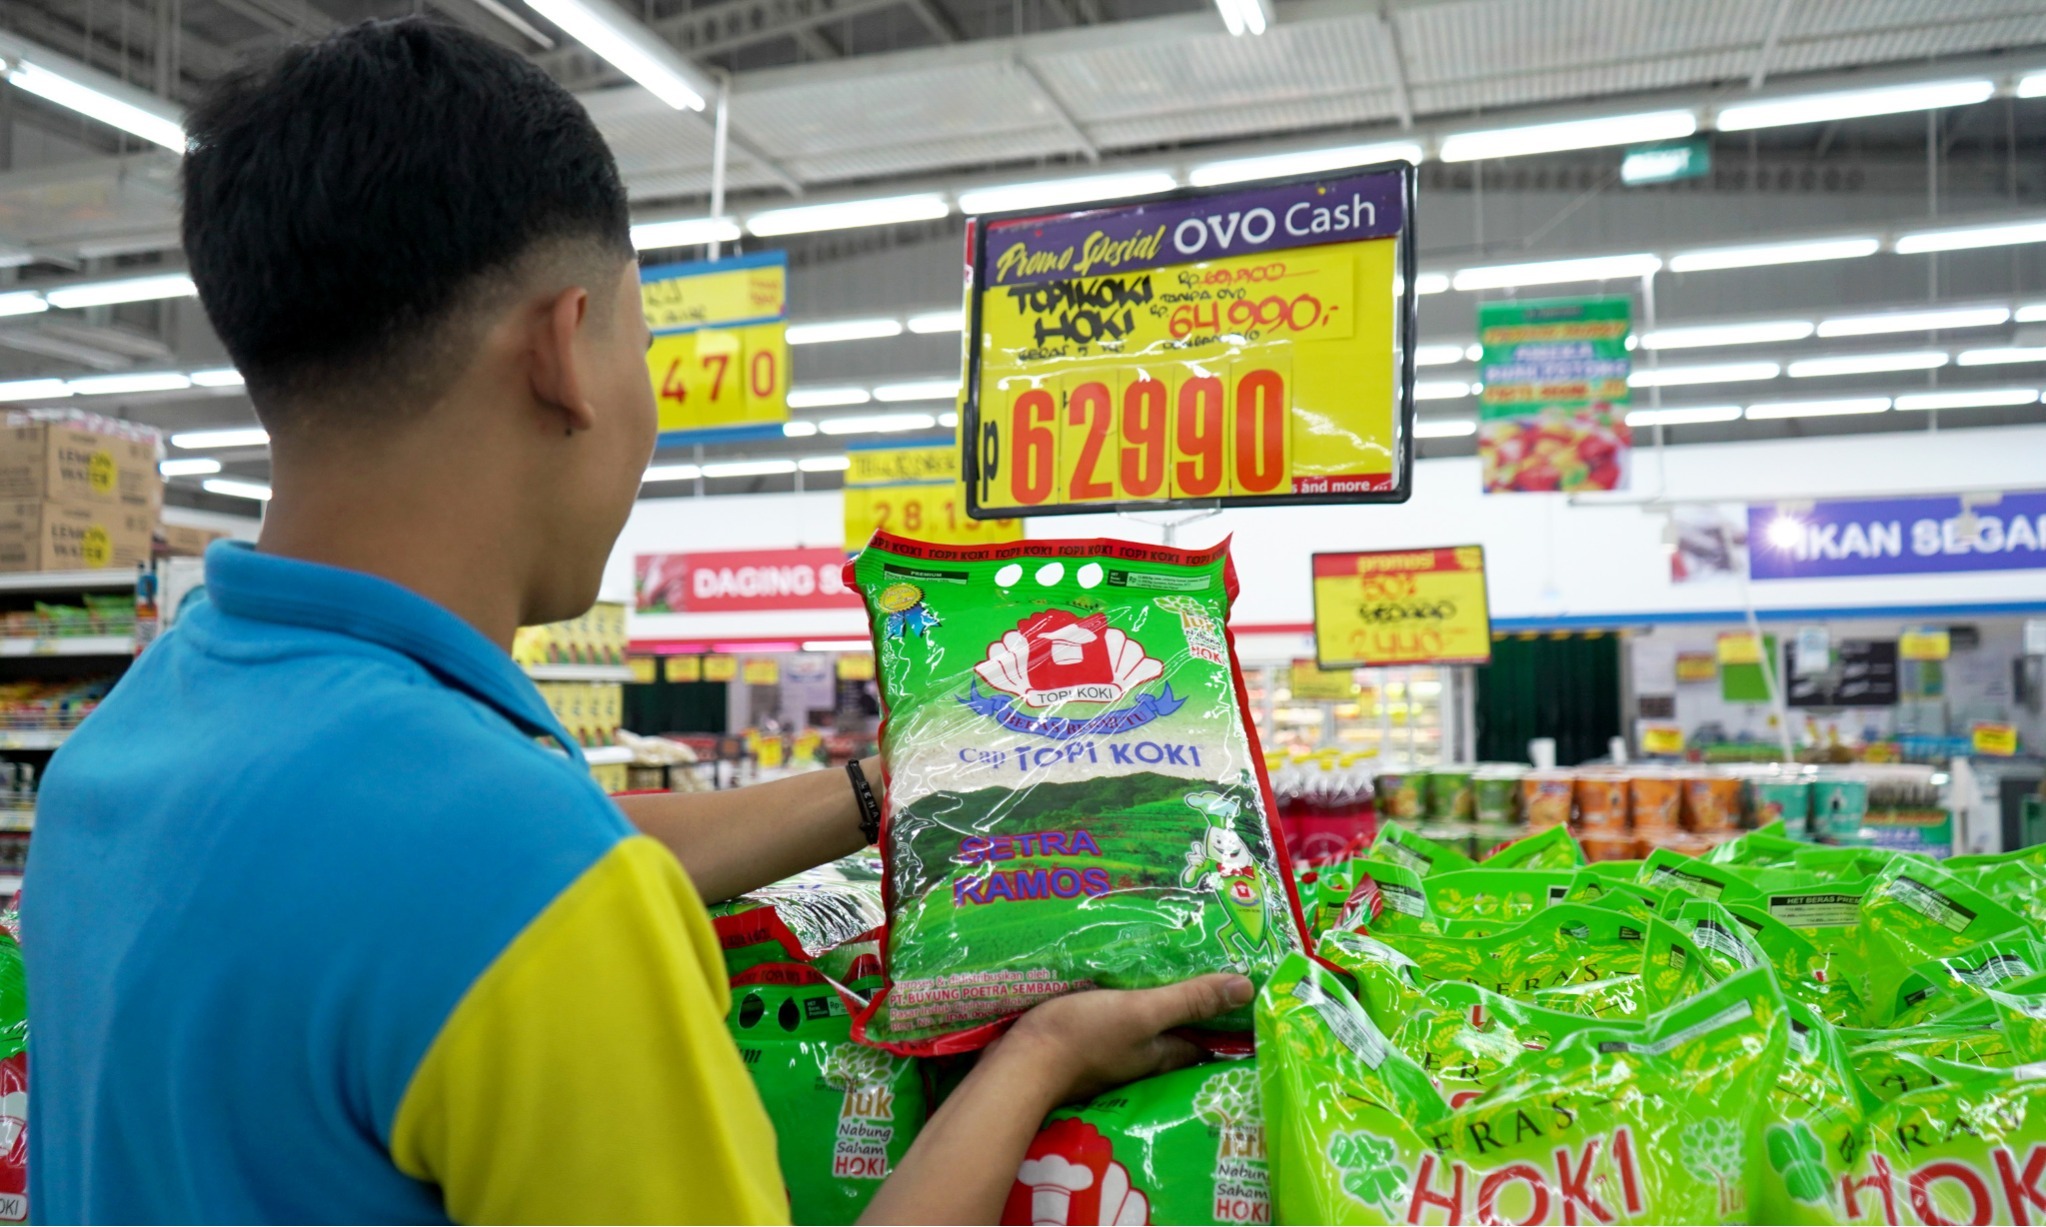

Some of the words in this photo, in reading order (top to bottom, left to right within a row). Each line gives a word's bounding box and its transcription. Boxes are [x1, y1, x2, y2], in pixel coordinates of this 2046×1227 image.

[996, 241, 1074, 283] Promo
[1073, 224, 1167, 276] Spesial
[1174, 207, 1276, 254] OVO
[1285, 193, 1377, 237] Cash
[1034, 308, 1136, 348] HOKI
[1010, 368, 1285, 506] 62990
[1301, 480, 1328, 494] and
[1023, 545, 1053, 556] KOKI
[693, 565, 816, 599] DAGING
[1037, 690, 1074, 704] TOPI
[1076, 687, 1113, 700] KOKI
[959, 746, 1006, 769] Cap
[1110, 741, 1202, 767] KOKI
[959, 829, 1103, 865] SETRA
[953, 867, 1111, 908] RAMOS
[936, 975, 945, 986] &
[1027, 969, 1051, 980] oleh
[829, 1001, 840, 1010] Rp
[889, 994, 906, 1006] PT.
[908, 990, 960, 1004] BUYUNG
[962, 984, 1008, 999] POETRA
[1012, 981, 1069, 995] SEMBADA
[890, 1007, 919, 1021] Pasar
[920, 1004, 950, 1017] Induk
[953, 1000, 999, 1016] Cipinang
[838, 1123, 892, 1142] Nabung
[1432, 1096, 1575, 1155] ERAS
[836, 1141, 884, 1156] Saham
[834, 1155, 886, 1177] HOKI
[1407, 1128, 1641, 1225] HOKI
[1216, 1183, 1269, 1200] Saham
[1216, 1197, 1271, 1224] HOKI
